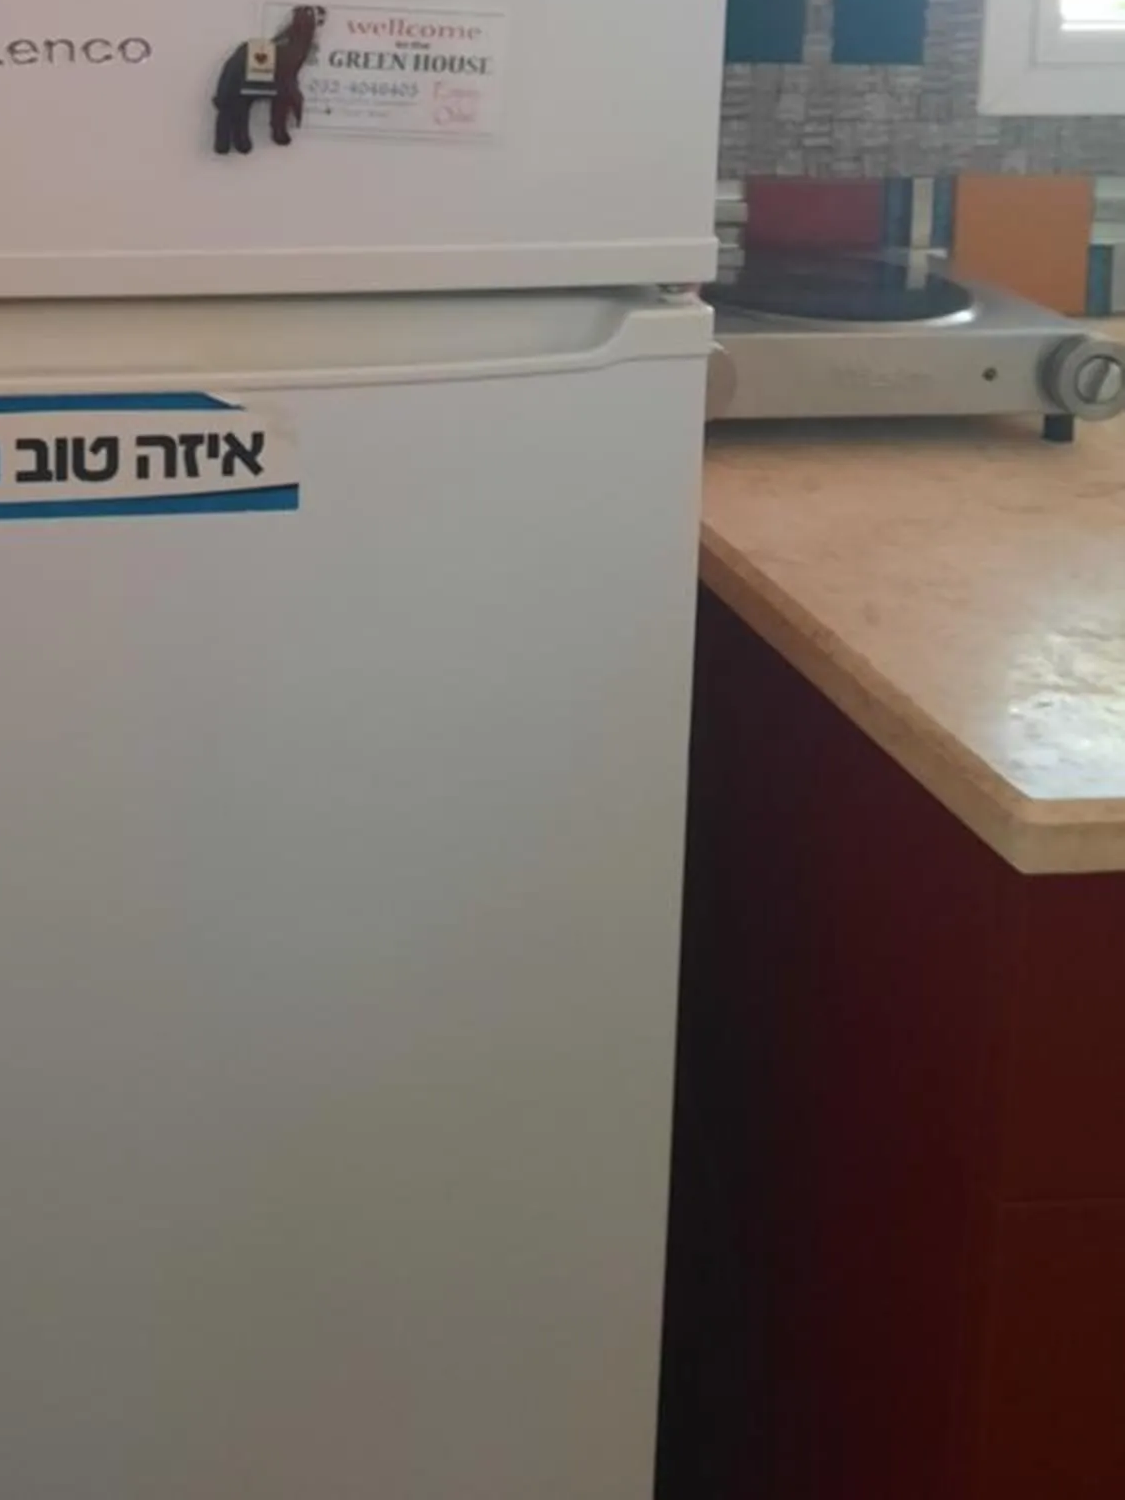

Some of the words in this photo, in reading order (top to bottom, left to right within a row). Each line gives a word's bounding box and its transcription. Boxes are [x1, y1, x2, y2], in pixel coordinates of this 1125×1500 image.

[347, 18, 483, 41] wellcome
[328, 50, 407, 71] GREEN
[412, 53, 493, 76] HOUSE
[15, 436, 119, 484] טוב
[136, 432, 265, 478] איזה
